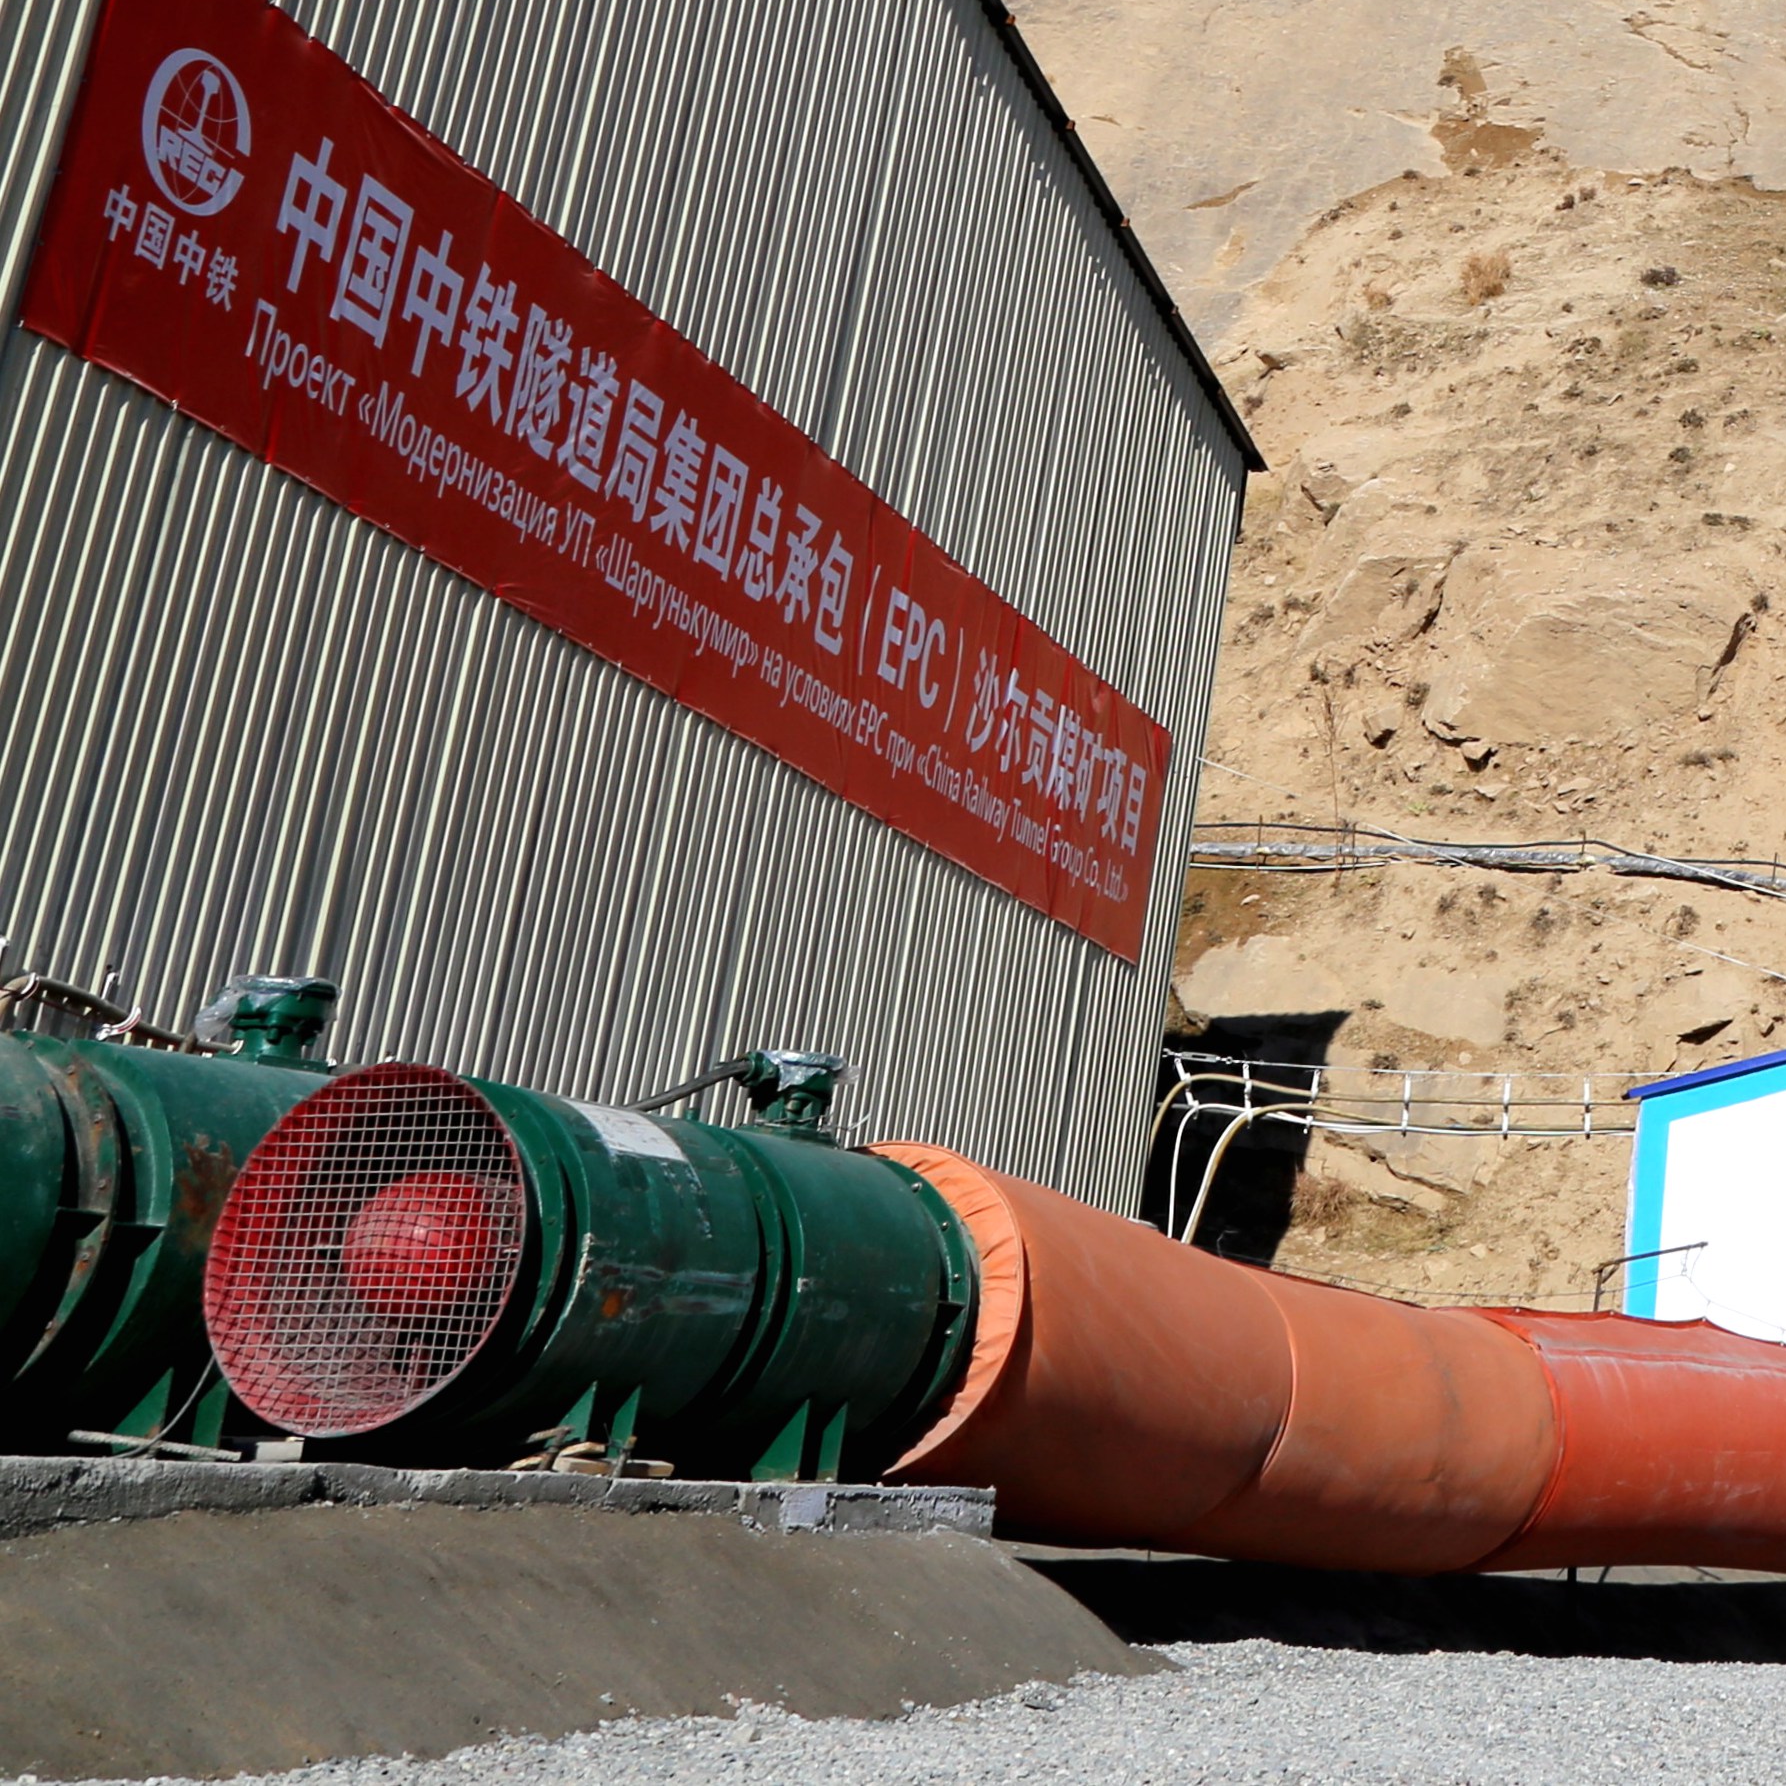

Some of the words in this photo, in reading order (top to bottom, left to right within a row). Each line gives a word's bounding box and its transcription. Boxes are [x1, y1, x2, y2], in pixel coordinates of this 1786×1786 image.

[103, 184, 239, 312] 中国中铁
[245, 298, 356, 416] Проект
[558, 501, 596, 568] УП
[760, 646, 783, 689] на
[779, 661, 857, 737] условиях
[885, 729, 916, 779] при
[961, 768, 1011, 843] Railway
[1011, 798, 1050, 857] Tunnel
[1051, 824, 1083, 887] Group
